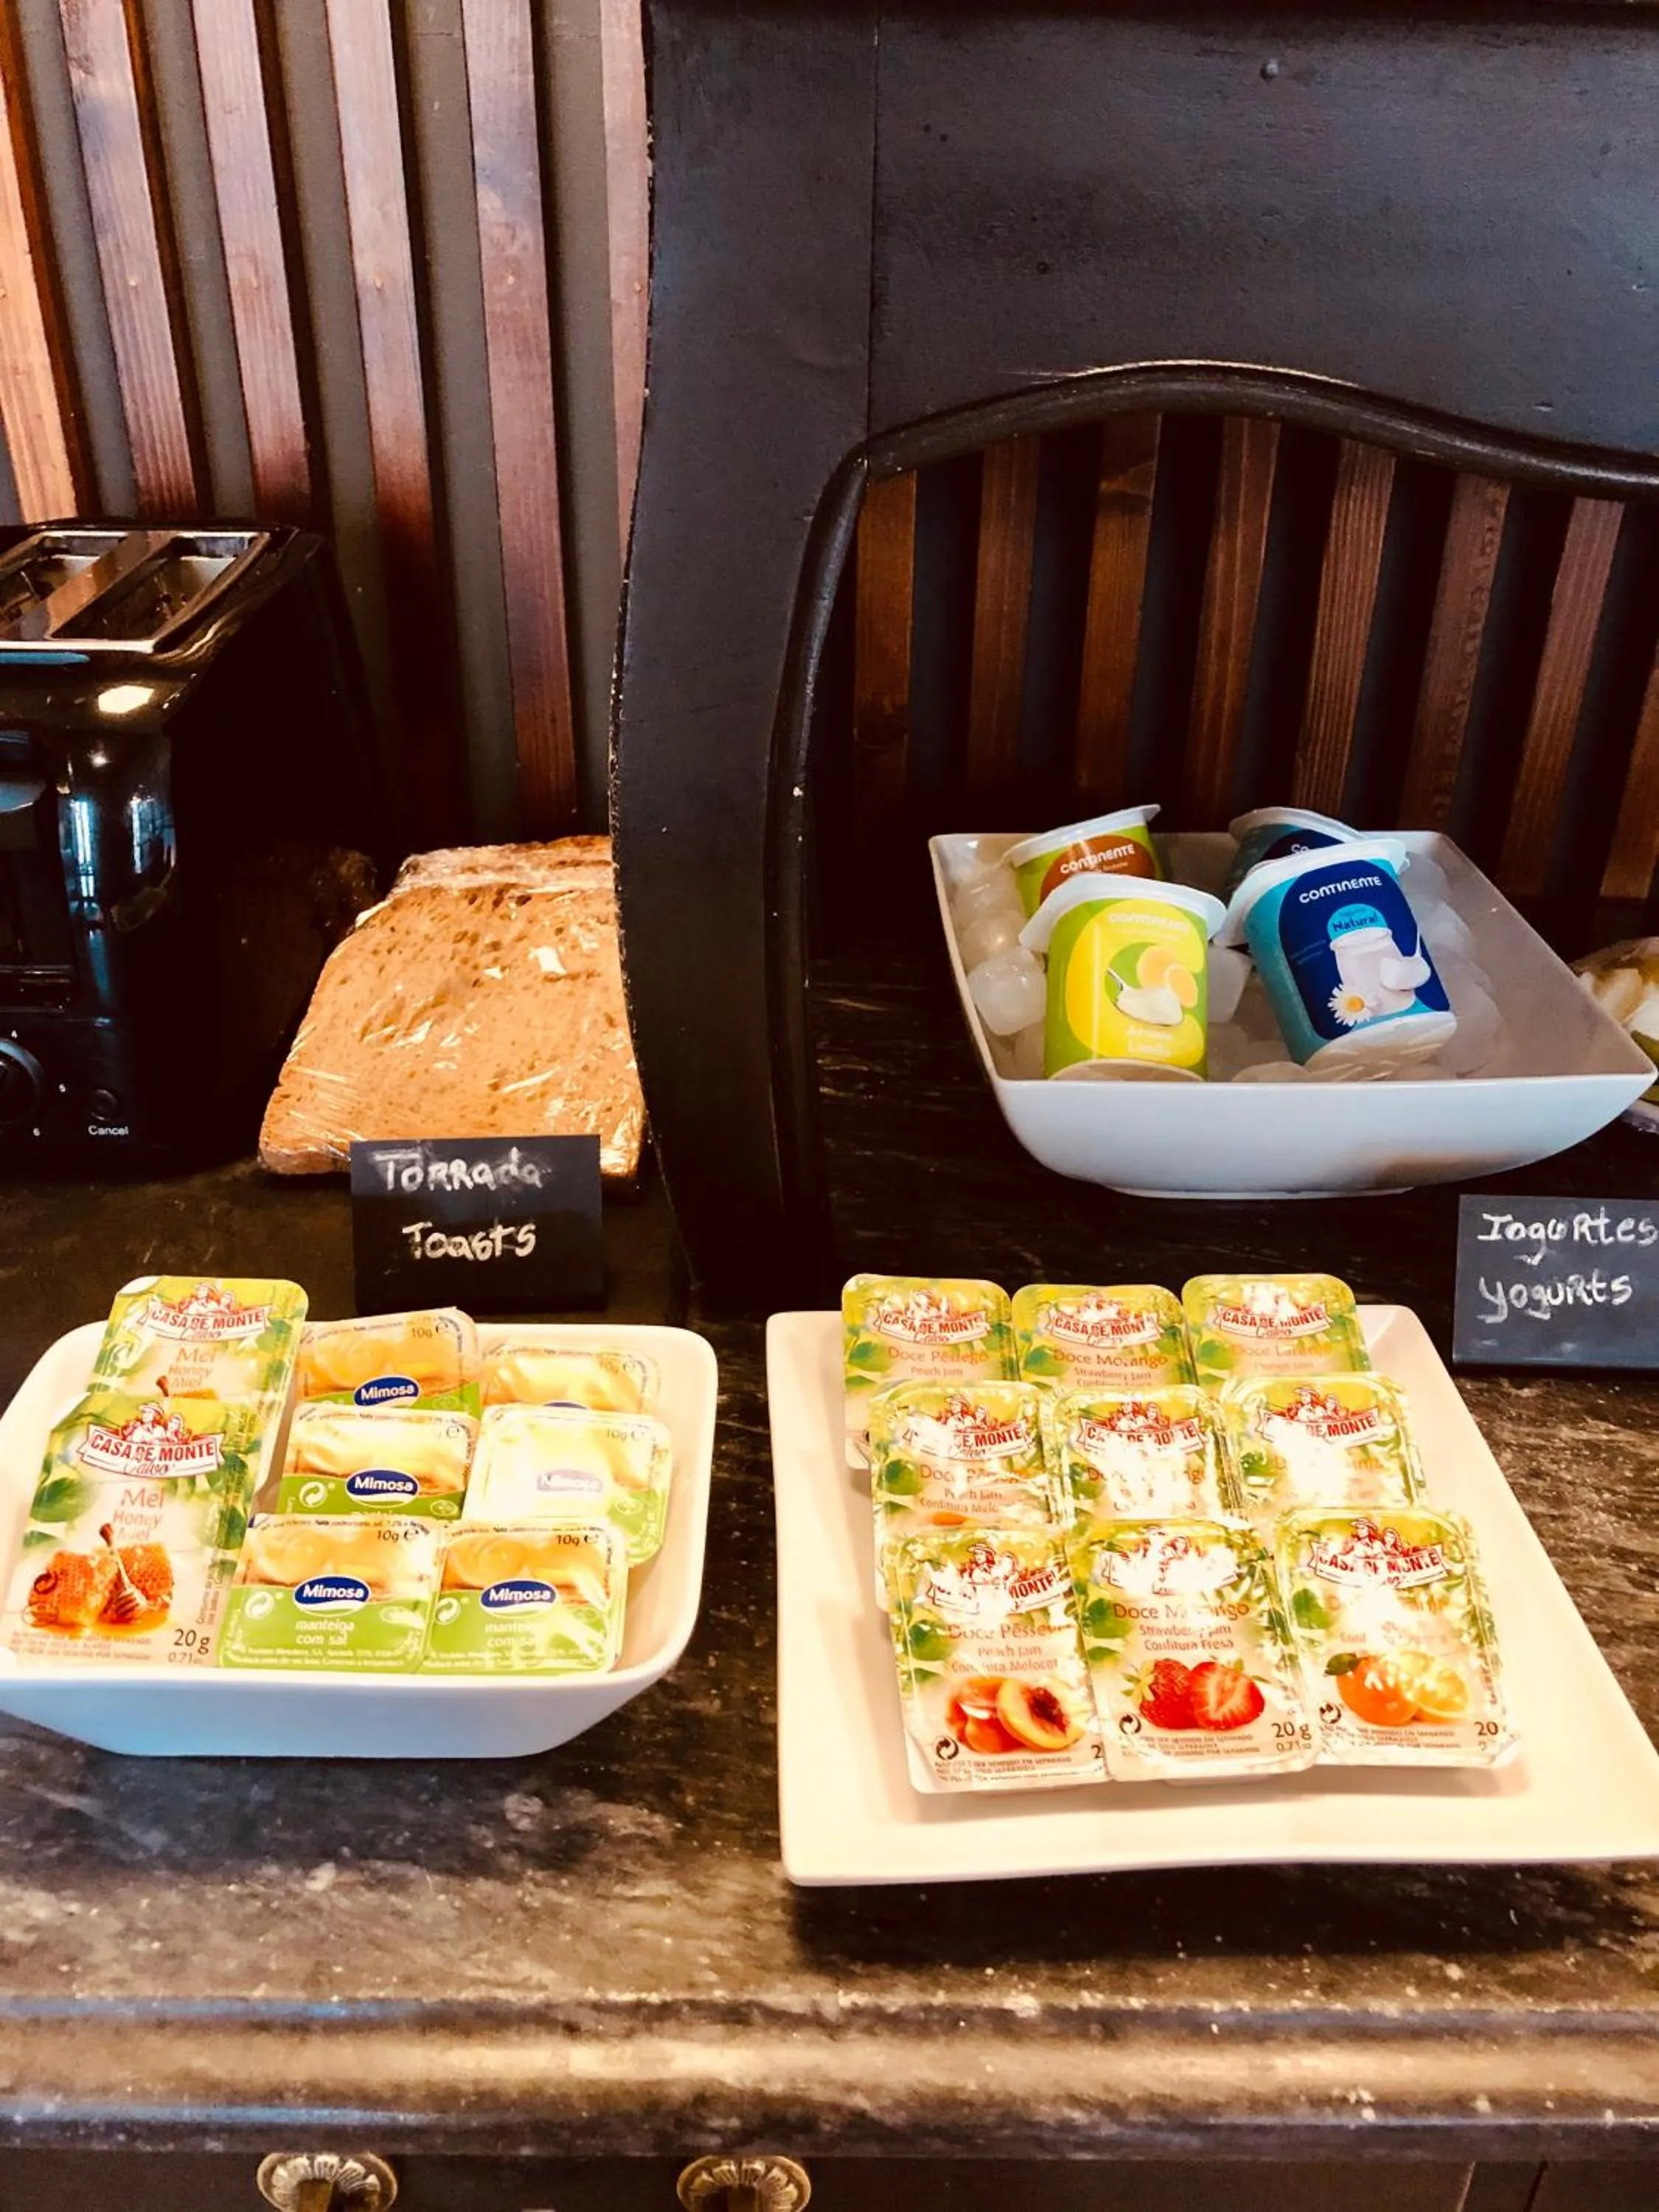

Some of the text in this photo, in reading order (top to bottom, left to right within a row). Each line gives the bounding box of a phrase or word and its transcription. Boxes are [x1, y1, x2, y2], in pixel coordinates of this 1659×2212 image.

[1299, 876, 1382, 903] CONTINENTE
[1332, 913, 1378, 932] Natural
[88, 1125, 129, 1135] Cancel
[151, 1309, 187, 1329] CASA
[212, 1310, 263, 1329] MONTE
[1055, 1317, 1088, 1335] CASA
[1222, 1311, 1257, 1327] CASA
[360, 1383, 415, 1400] Mimosa
[1327, 1415, 1376, 1437] MONTE
[974, 1427, 1022, 1447] MONTE
[91, 1433, 131, 1459] CASA
[159, 1440, 215, 1462] MONTE
[354, 1476, 414, 1492] Mimosa
[120, 1486, 165, 1509] Mel
[377, 1529, 400, 1543] 10g
[555, 1534, 580, 1546] 10g
[303, 1584, 366, 1600] Mimosa
[488, 1588, 551, 1602] Mimosa
[1113, 1602, 1158, 1618] Doce
[296, 1619, 355, 1635] manteiga
[173, 1627, 197, 1646] 20
[198, 1635, 211, 1655] g
[296, 1630, 348, 1646] com sal
[1271, 1721, 1295, 1739] 20
[1298, 1725, 1312, 1741] g
[1474, 1721, 1498, 1736] 20
